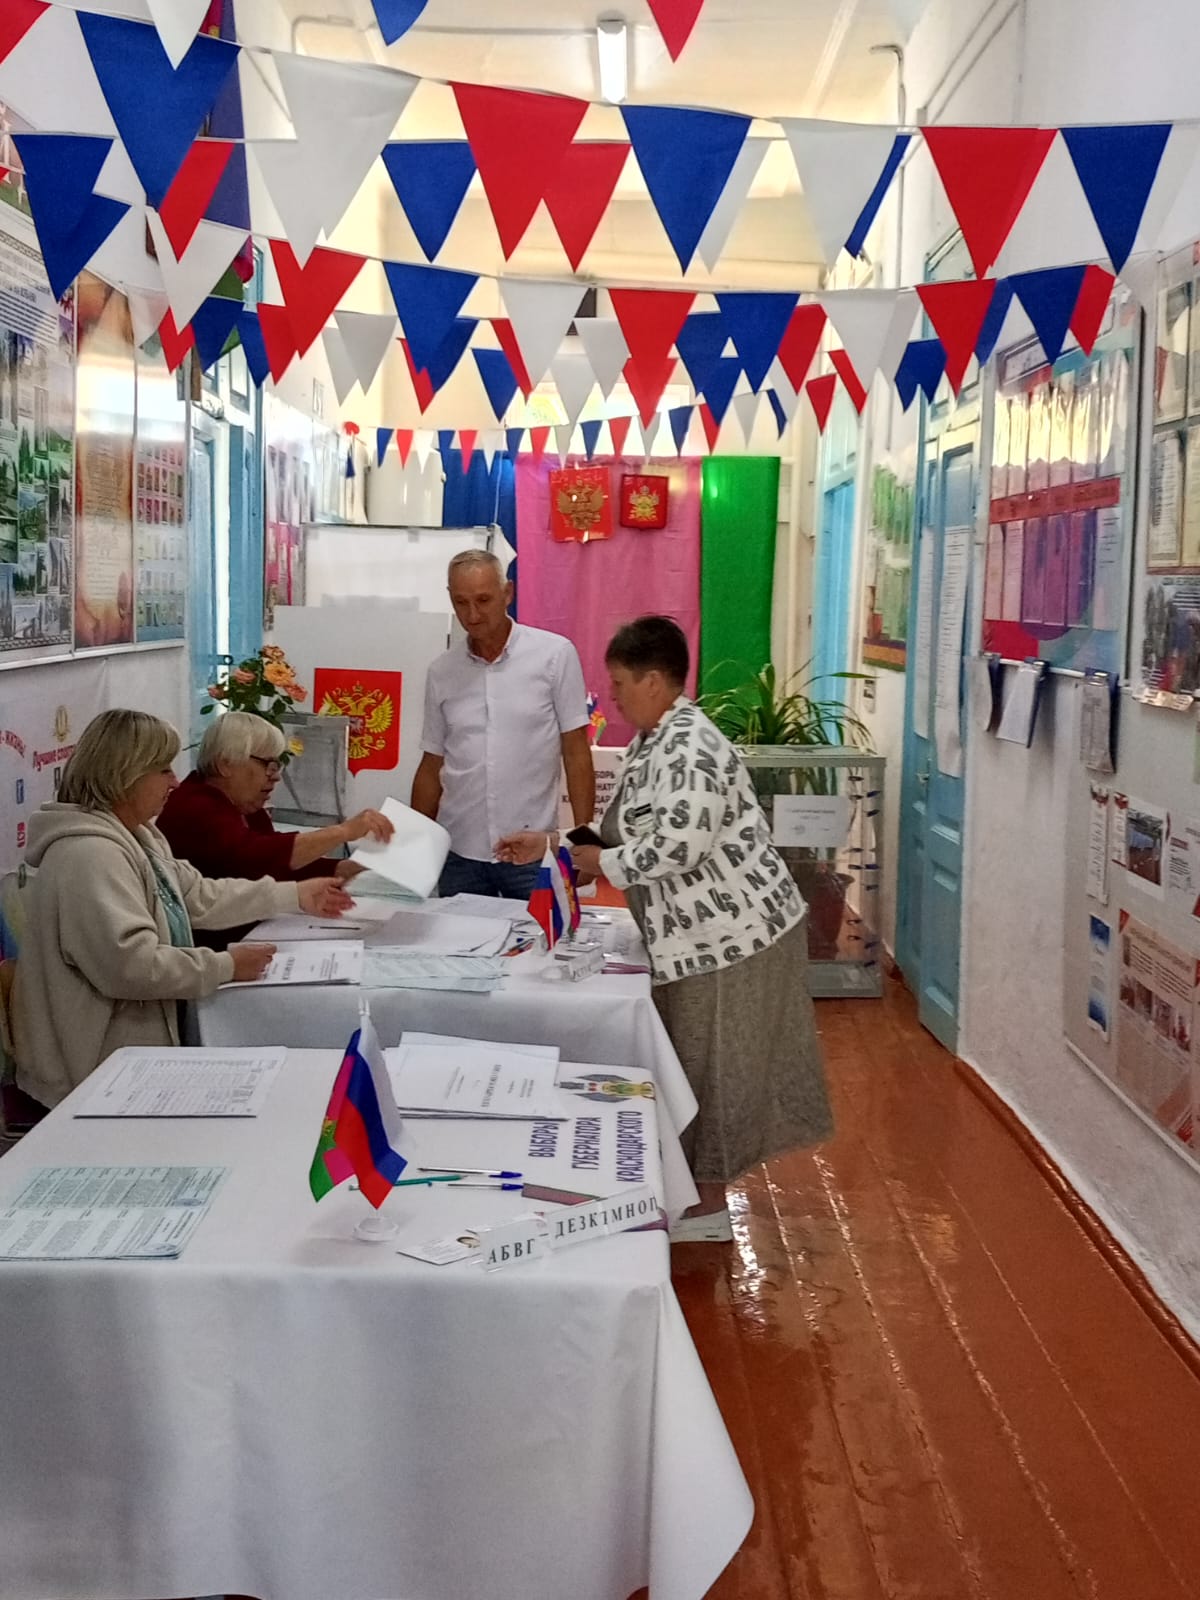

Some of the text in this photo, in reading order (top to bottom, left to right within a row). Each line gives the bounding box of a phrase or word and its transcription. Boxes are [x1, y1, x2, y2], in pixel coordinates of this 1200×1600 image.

[528, 1121, 559, 1158] ВЫБОРЫ
[571, 1117, 602, 1170] ГУБЕРНАТОРА
[616, 1111, 648, 1182] КРАСНОДАРСКОГО
